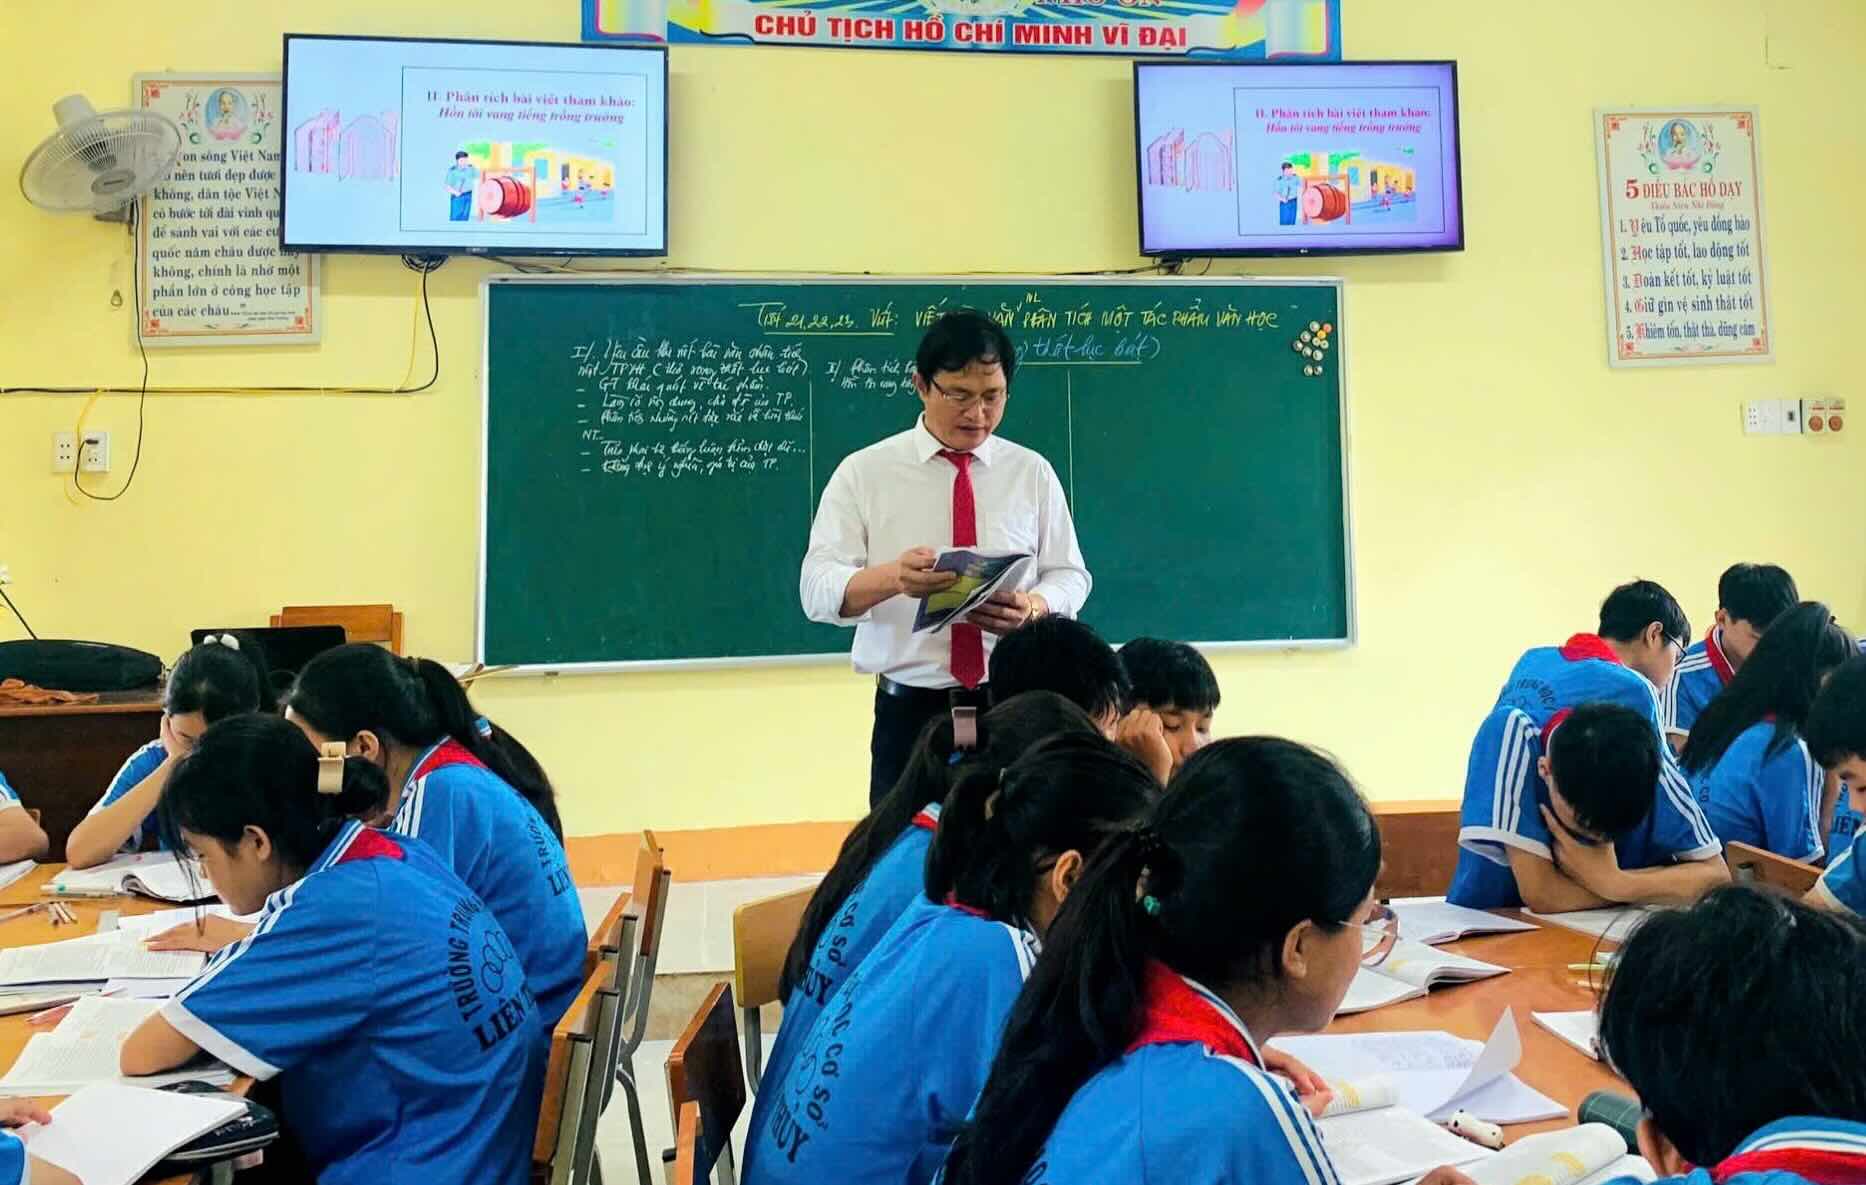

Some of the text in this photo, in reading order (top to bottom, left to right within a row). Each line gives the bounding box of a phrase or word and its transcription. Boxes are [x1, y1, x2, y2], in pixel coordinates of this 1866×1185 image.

[755, 10, 1186, 50] CHỦ TỊCH HỒ CHÍ MINH VĨ ĐẠI
[230, 149, 254, 163] Việt
[245, 187, 269, 202] Việt
[1625, 179, 1640, 200] 5
